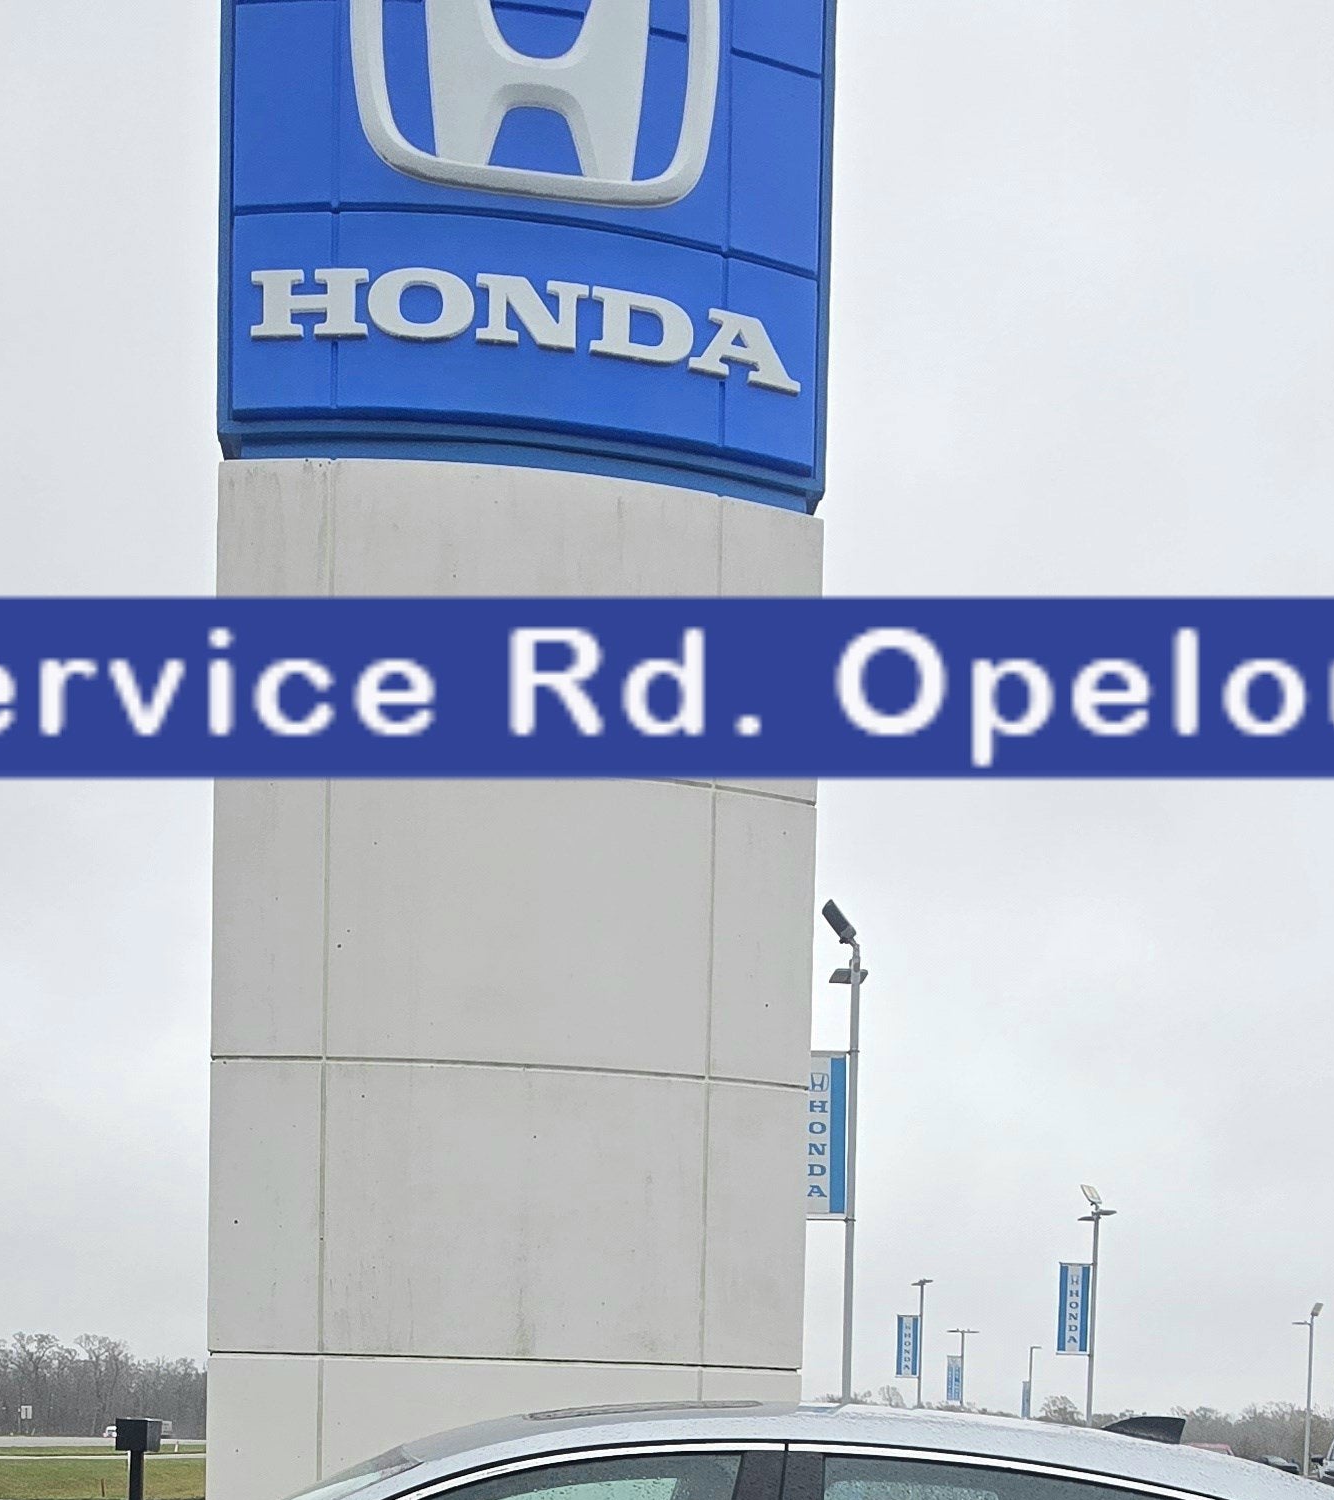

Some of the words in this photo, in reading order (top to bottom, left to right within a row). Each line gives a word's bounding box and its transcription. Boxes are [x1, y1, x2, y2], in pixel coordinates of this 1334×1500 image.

[250, 267, 801, 395] HONDA
[807, 1100, 828, 1197] HONDA
[1067, 1289, 1079, 1343] HONDA
